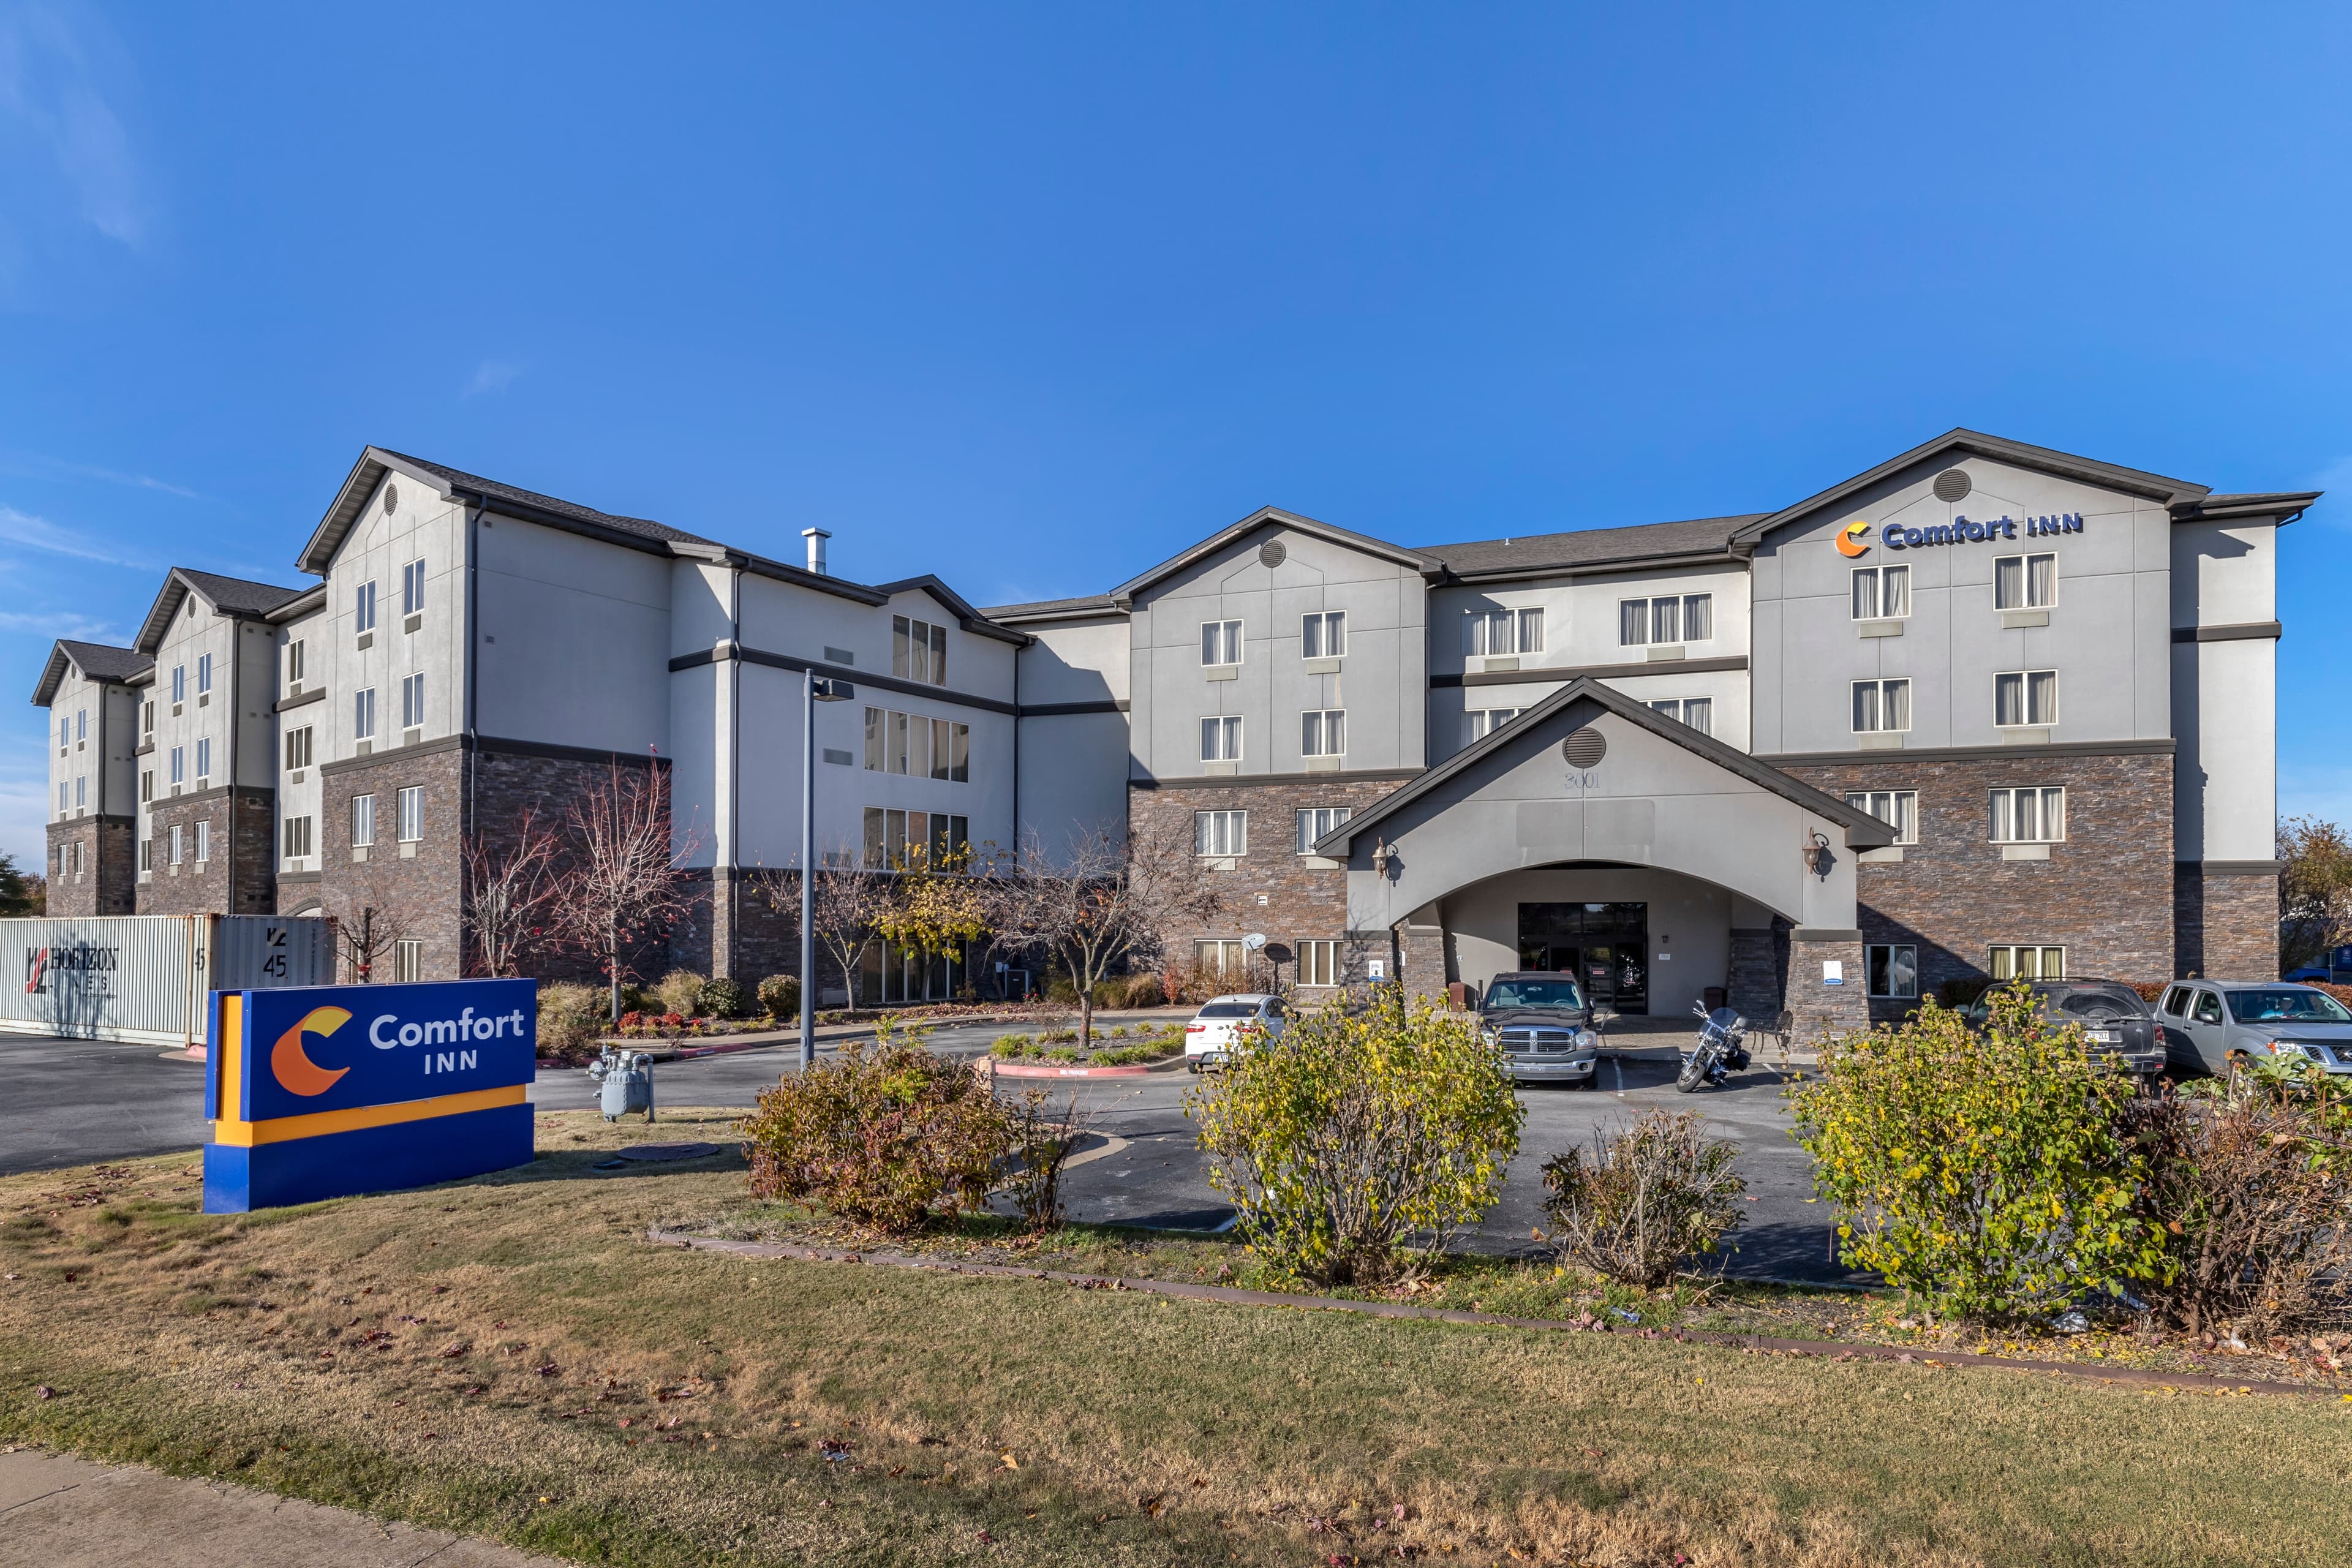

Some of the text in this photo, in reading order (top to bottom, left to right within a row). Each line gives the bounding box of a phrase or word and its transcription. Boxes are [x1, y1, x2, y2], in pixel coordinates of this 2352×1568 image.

[1881, 515, 2013, 548] Comfort
[2026, 512, 2079, 535] INN
[1564, 772, 1600, 789] 3001
[50, 947, 119, 971] HORIZON
[263, 955, 287, 978] 45
[369, 1006, 525, 1050] Comfort
[424, 1049, 478, 1075] INN
